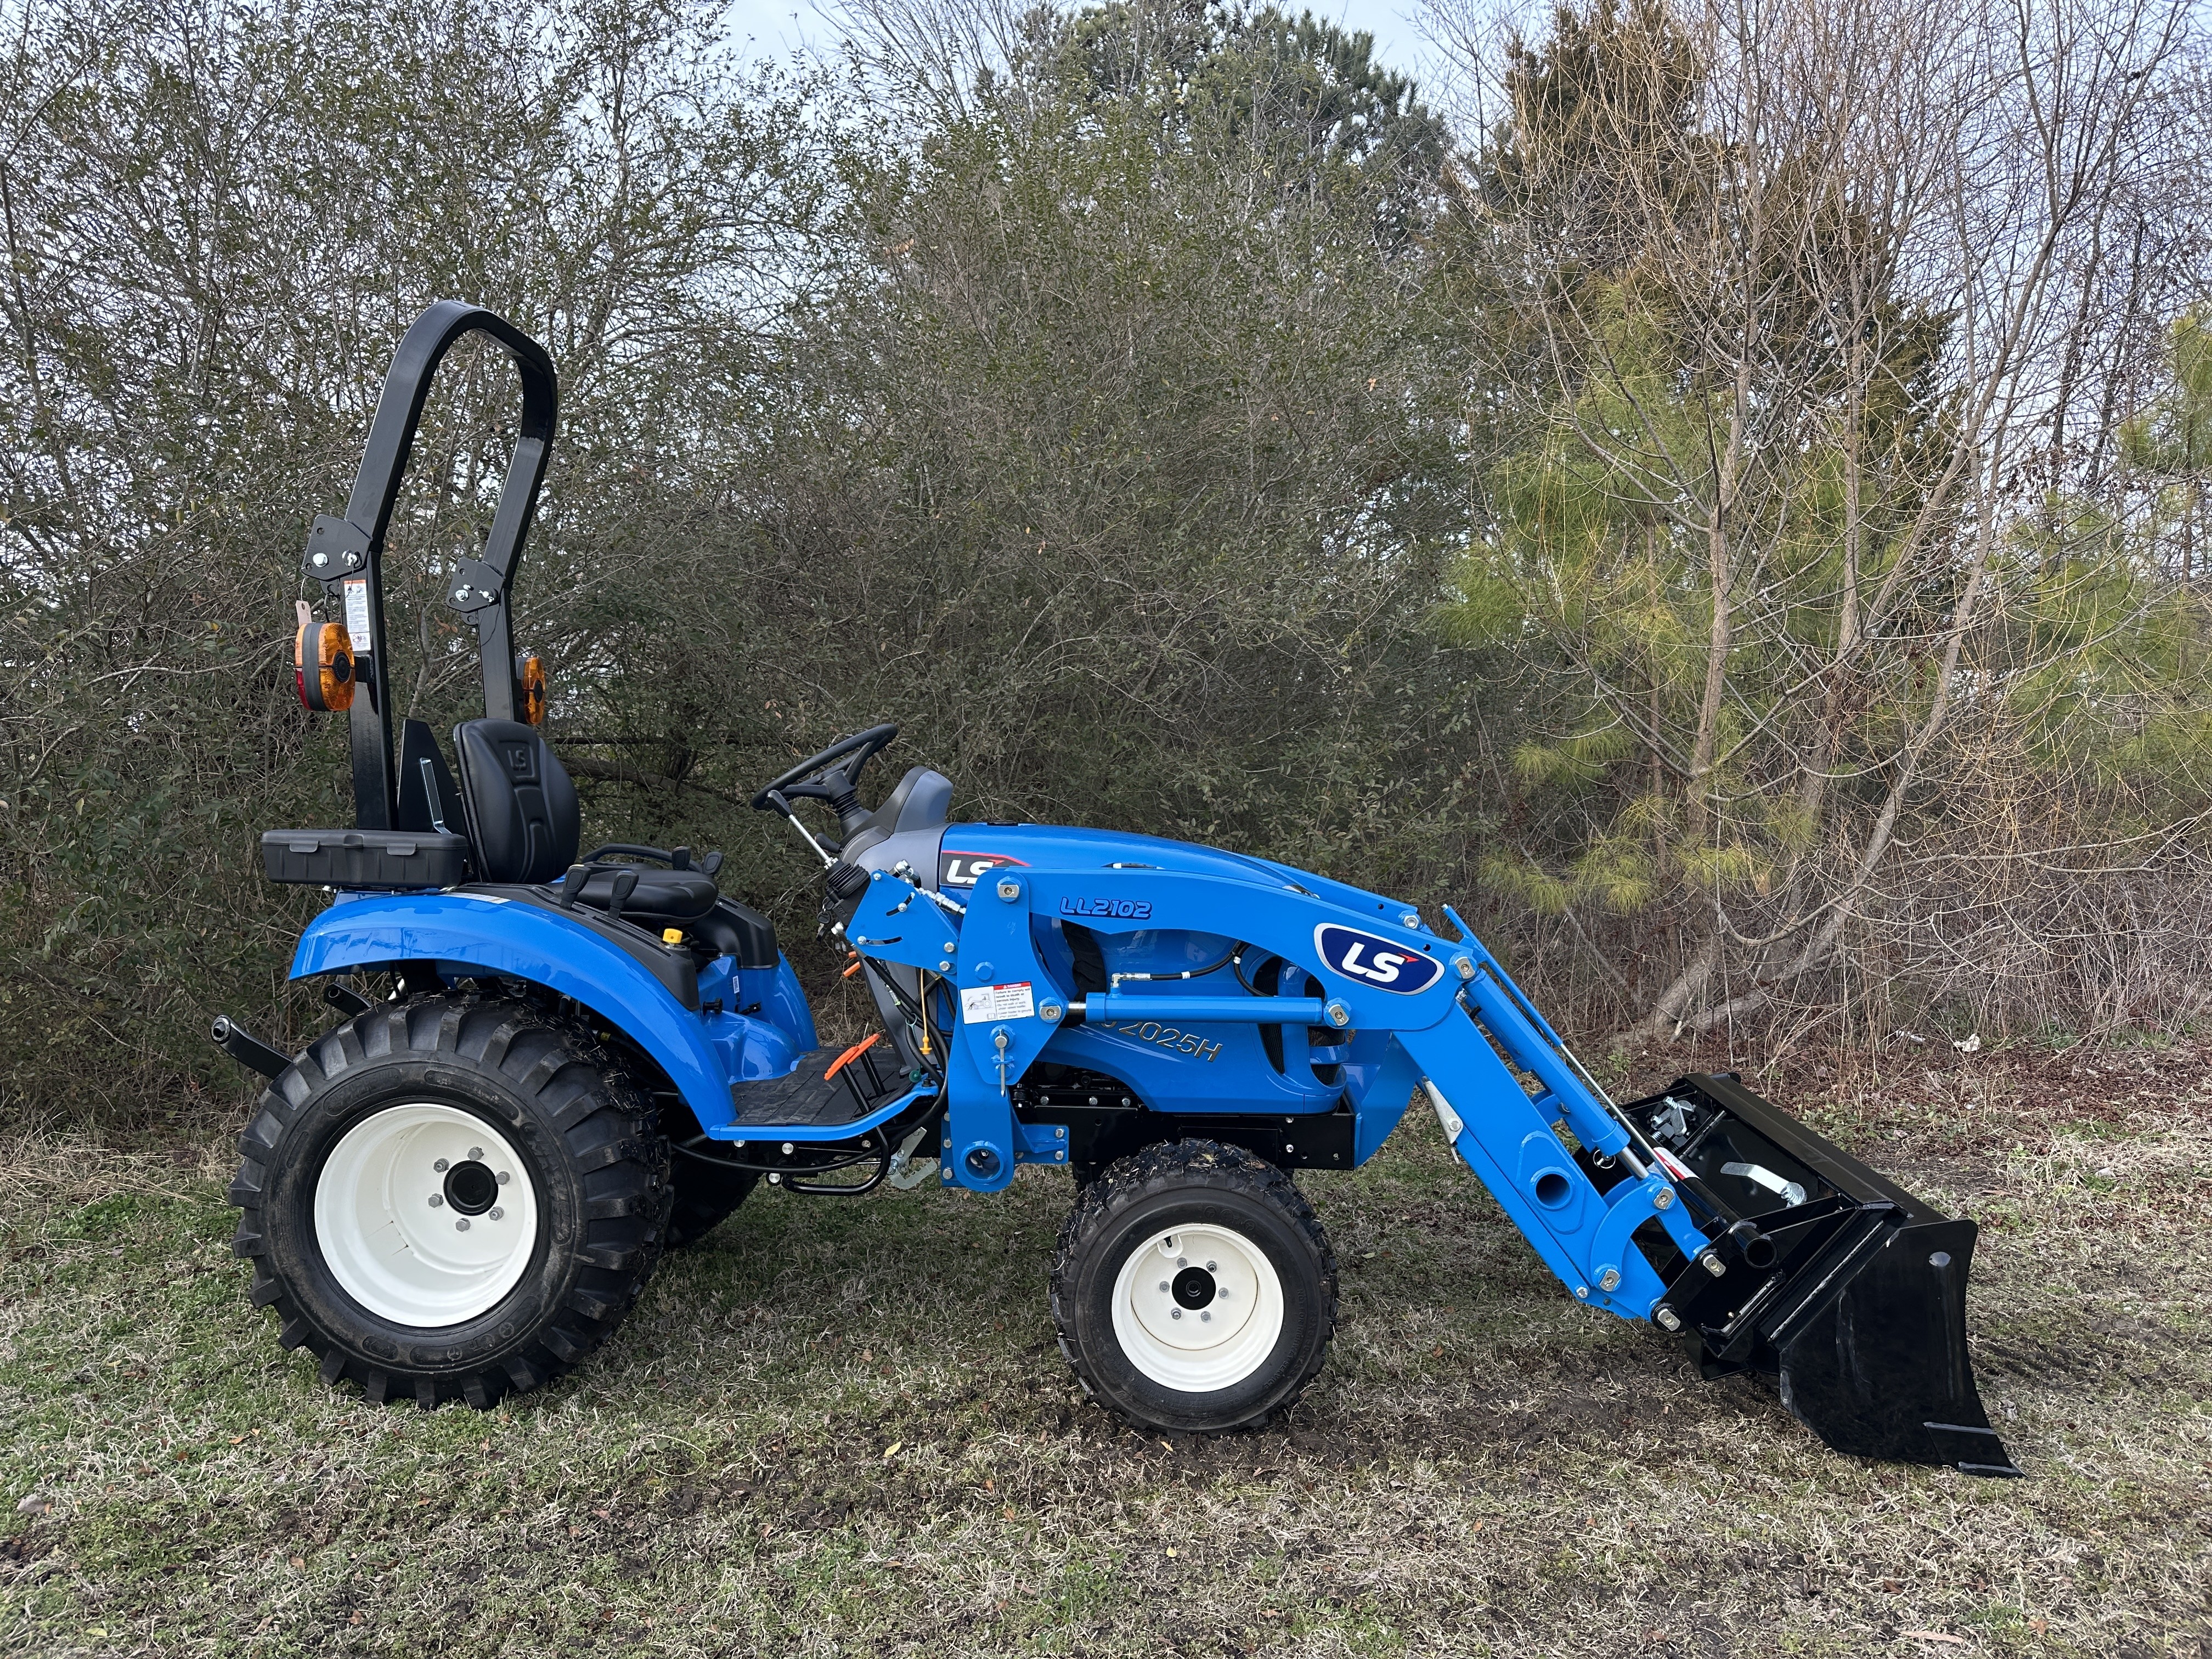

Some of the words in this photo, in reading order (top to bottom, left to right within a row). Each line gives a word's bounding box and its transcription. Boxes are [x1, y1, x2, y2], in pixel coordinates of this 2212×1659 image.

[507, 749, 527, 771] LS
[946, 859, 994, 884] LS
[1059, 896, 1153, 920] LL2102
[1341, 941, 1406, 983] LS
[1264, 1360, 1289, 1389] SERVICE
